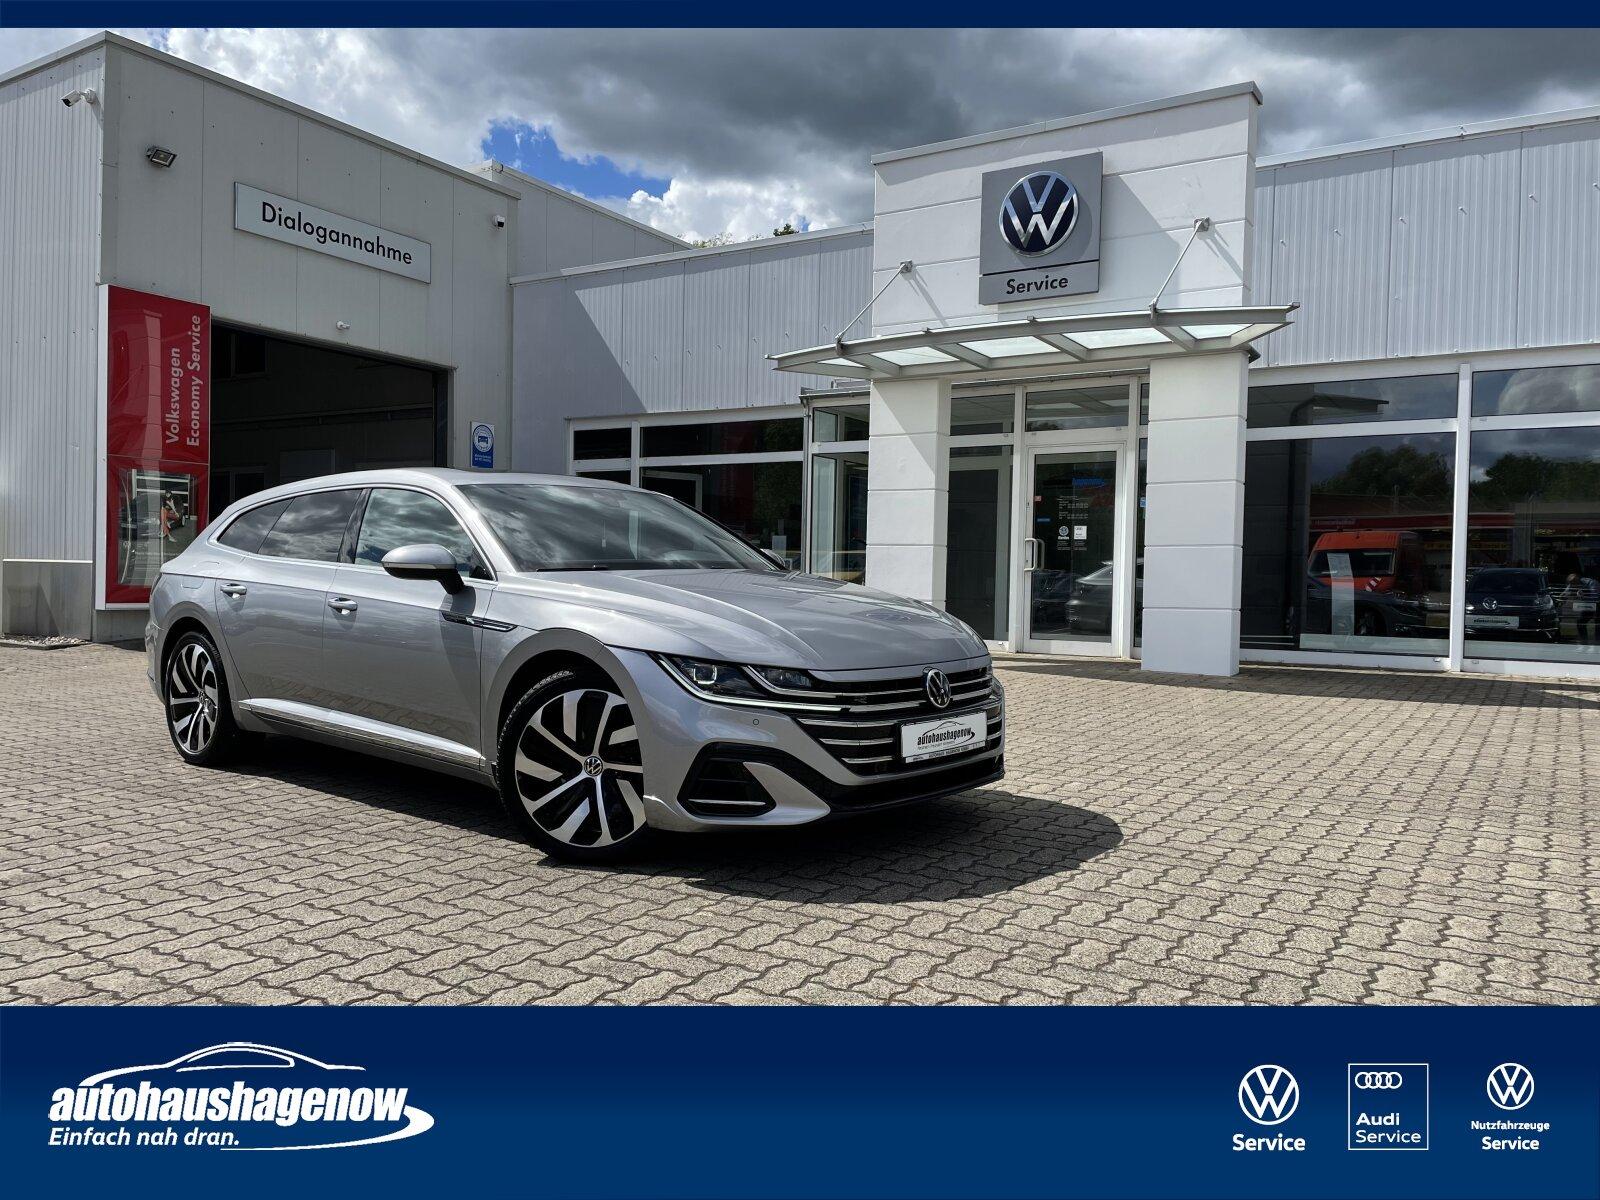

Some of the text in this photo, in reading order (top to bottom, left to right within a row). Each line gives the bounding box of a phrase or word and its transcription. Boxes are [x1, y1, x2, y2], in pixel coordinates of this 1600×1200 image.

[261, 201, 412, 265] Dialogannahme
[1006, 275, 1069, 295] Service
[166, 347, 184, 443] Volkswagen
[187, 315, 203, 446] Economy Service
